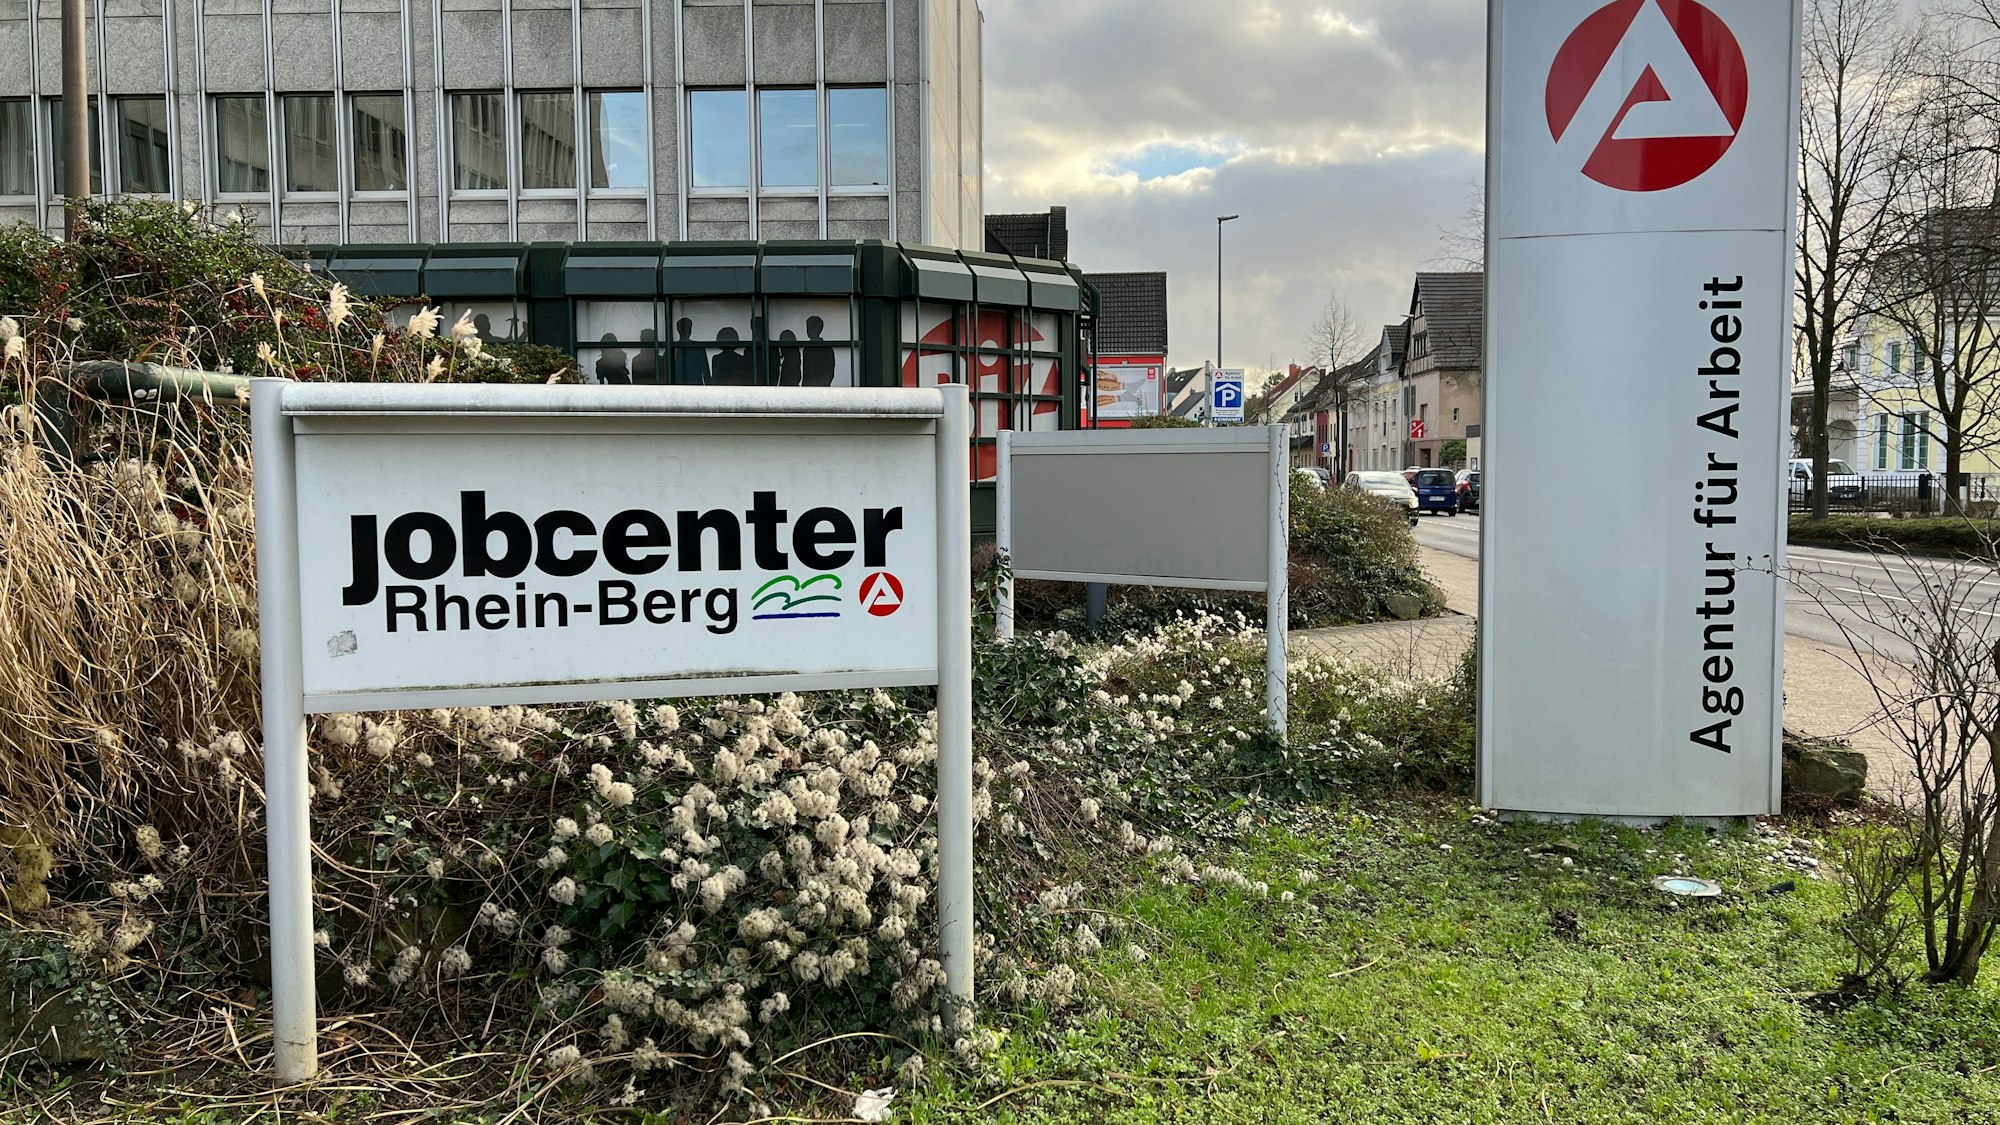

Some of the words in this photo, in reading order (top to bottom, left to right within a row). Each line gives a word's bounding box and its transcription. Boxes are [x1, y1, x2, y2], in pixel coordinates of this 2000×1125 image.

[1221, 390, 1236, 407] P
[1696, 275, 1743, 439] Arbeit
[1693, 452, 1738, 529] für
[342, 490, 903, 606] jobcenter
[385, 581, 738, 635] Rhein-Berg
[1689, 542, 1744, 754] Agentur
